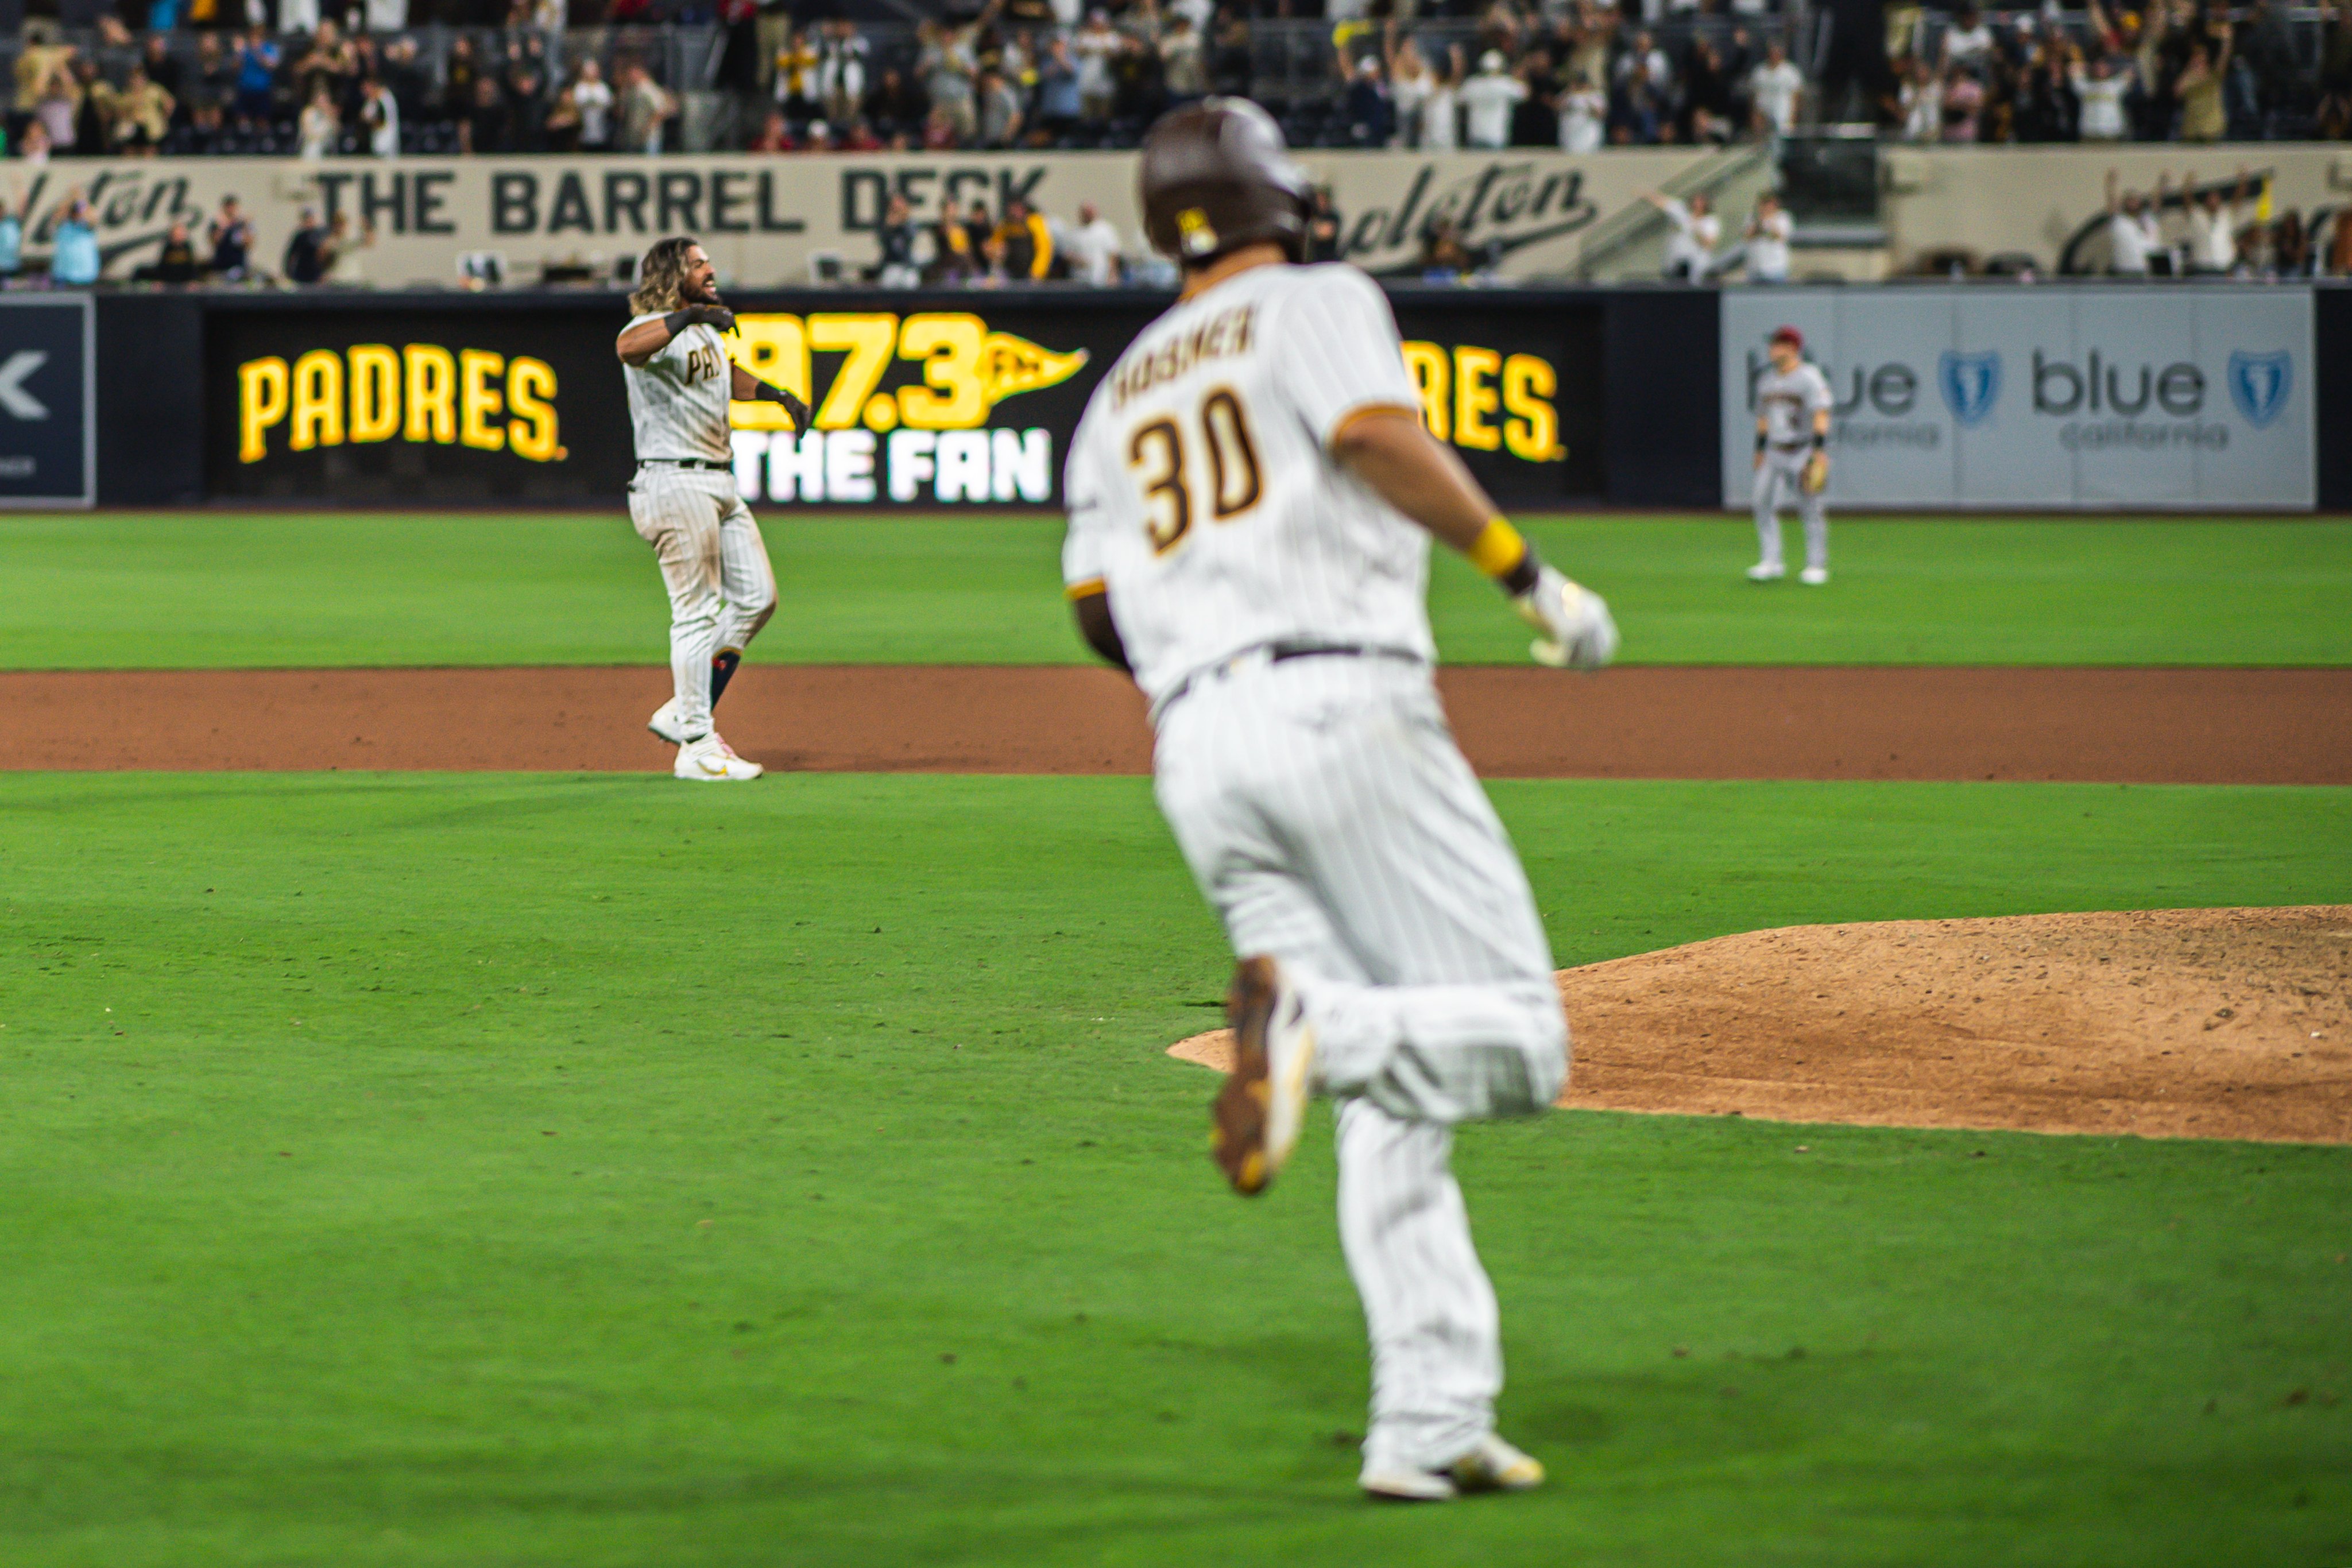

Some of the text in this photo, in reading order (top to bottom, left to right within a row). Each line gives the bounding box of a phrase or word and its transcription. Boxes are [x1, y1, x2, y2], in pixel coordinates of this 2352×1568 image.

[309, 171, 457, 234] THE
[490, 171, 806, 234] BARREL
[237, 343, 559, 463] PADRES
[719, 312, 990, 433] 97.3
[2032, 347, 2206, 417] blue
[730, 428, 1052, 502] THE FAN
[1129, 382, 1266, 553] 30
